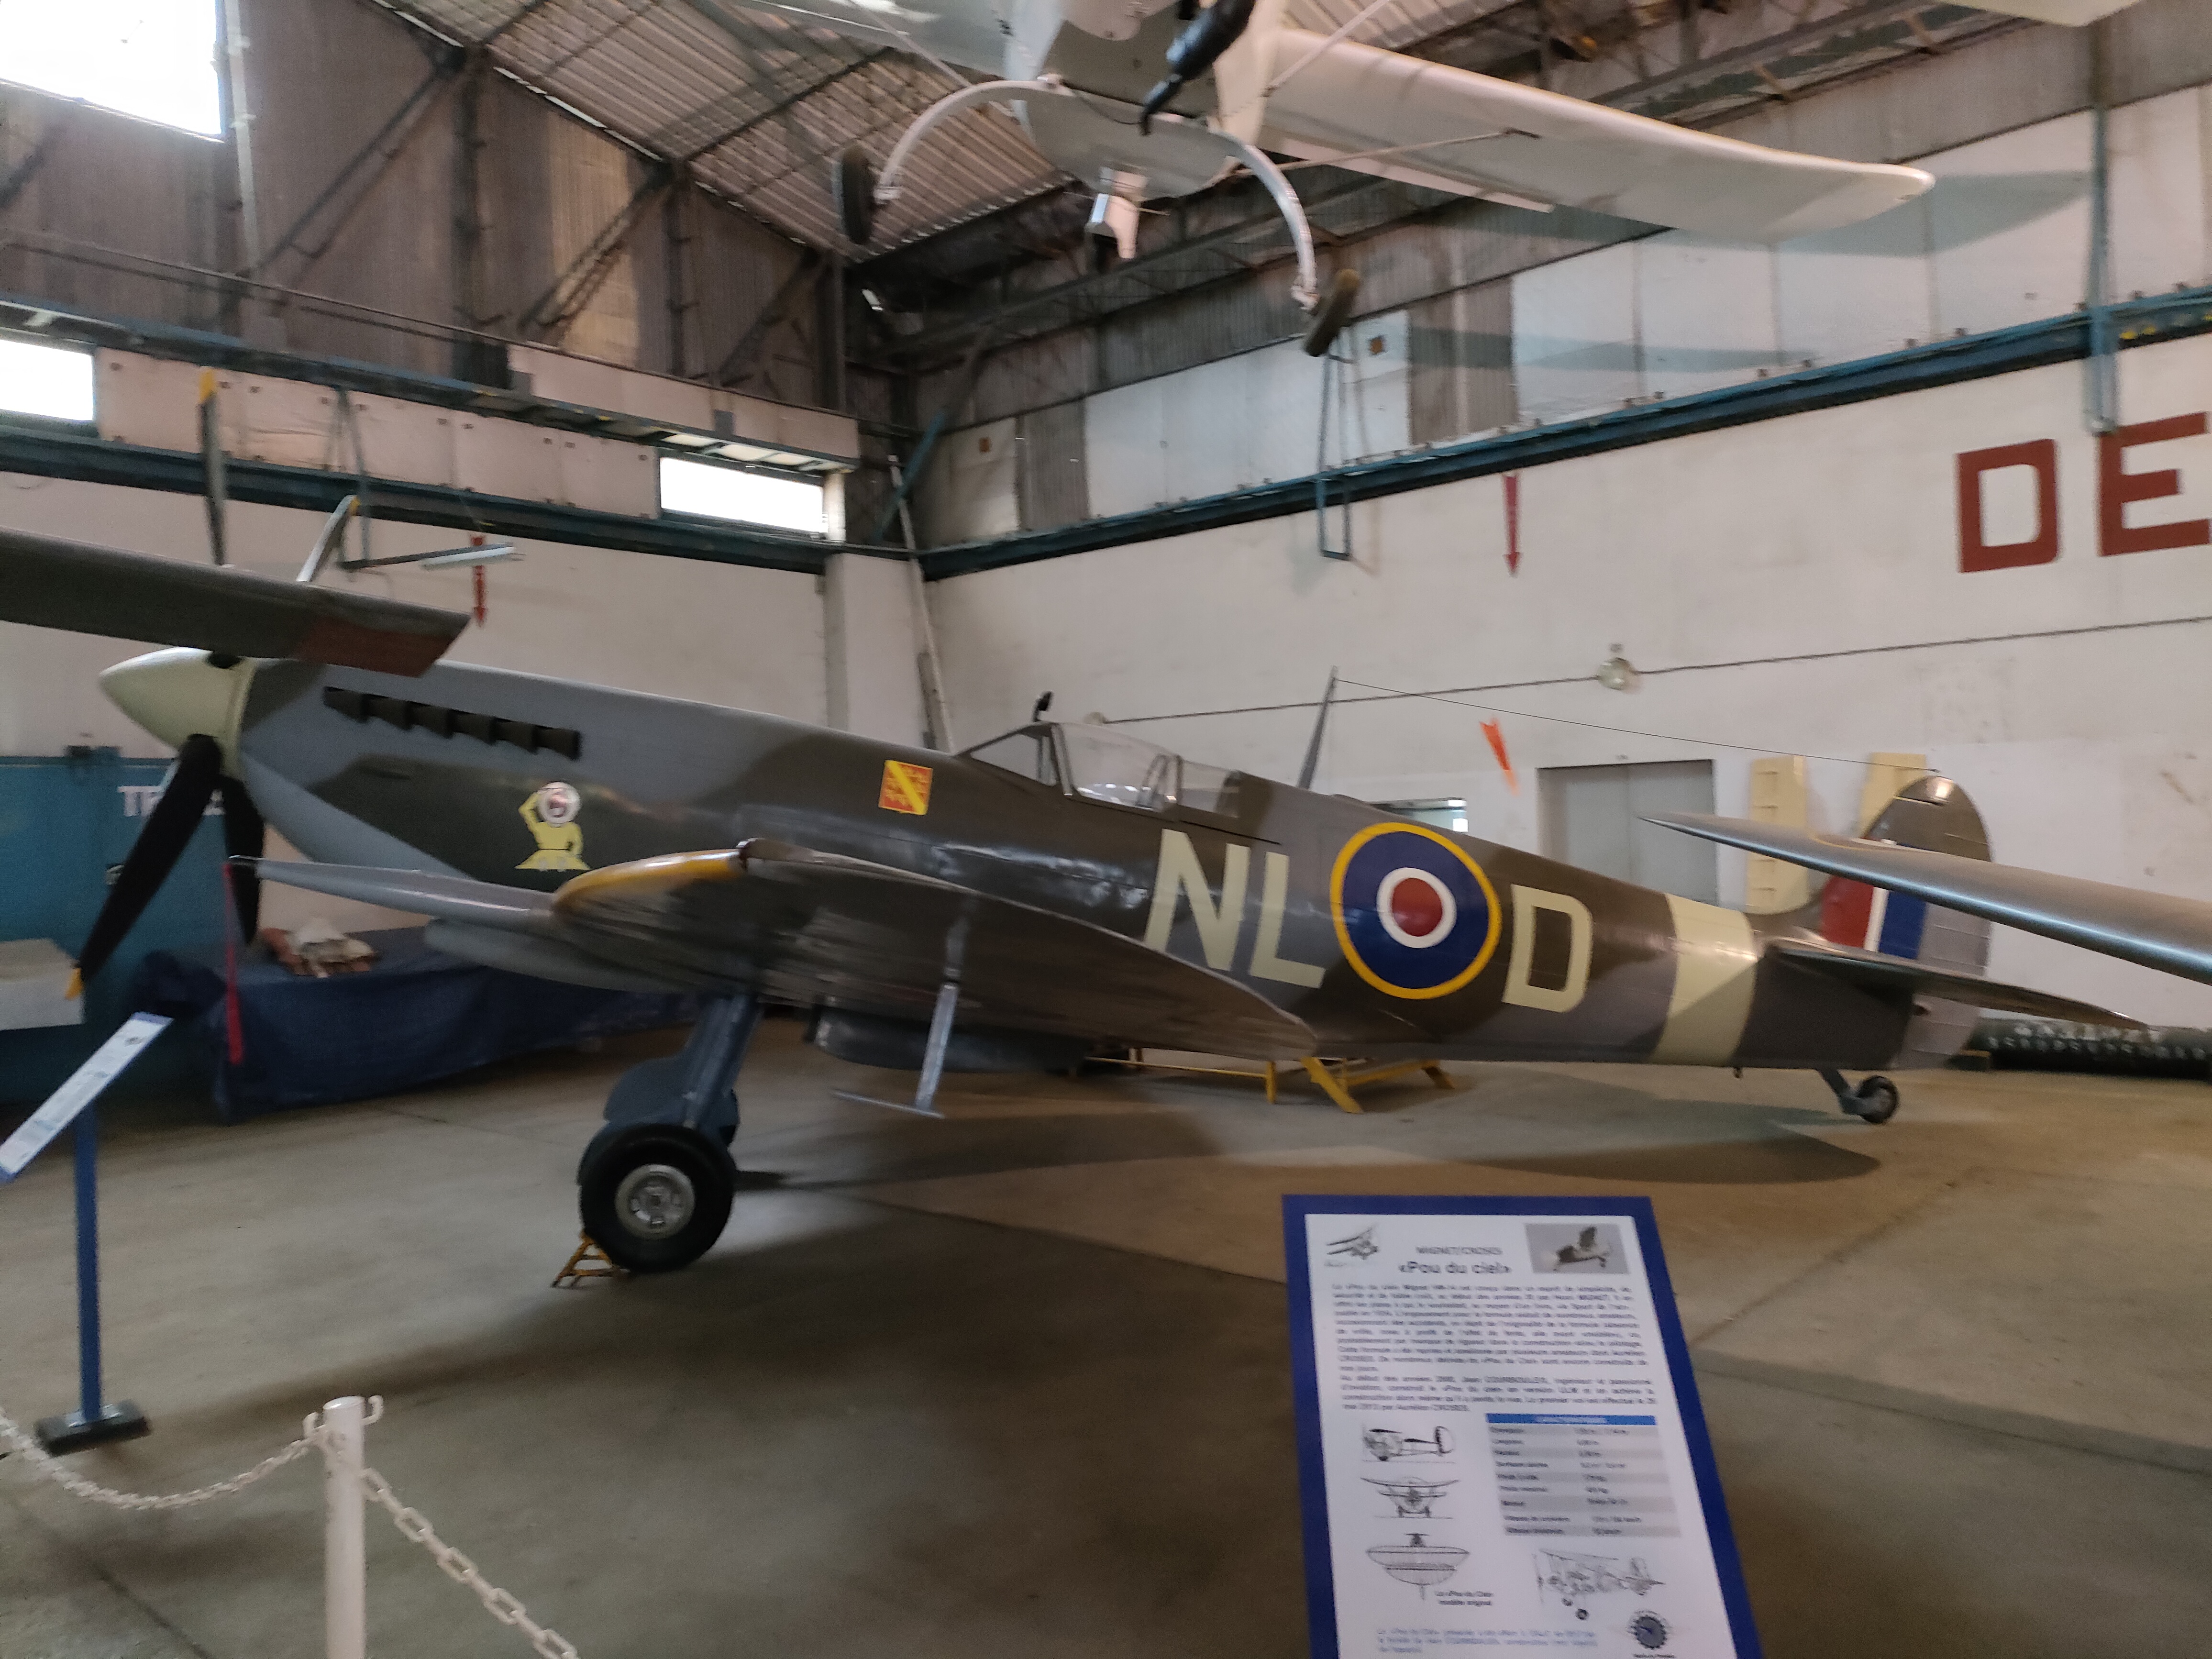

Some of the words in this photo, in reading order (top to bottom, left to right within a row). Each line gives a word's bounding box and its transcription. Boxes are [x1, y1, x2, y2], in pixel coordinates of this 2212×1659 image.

[1955, 409, 2211, 574] DE
[1144, 828, 1326, 989] NL
[1501, 884, 1593, 1013] D
[1445, 1261, 1467, 1274] du
